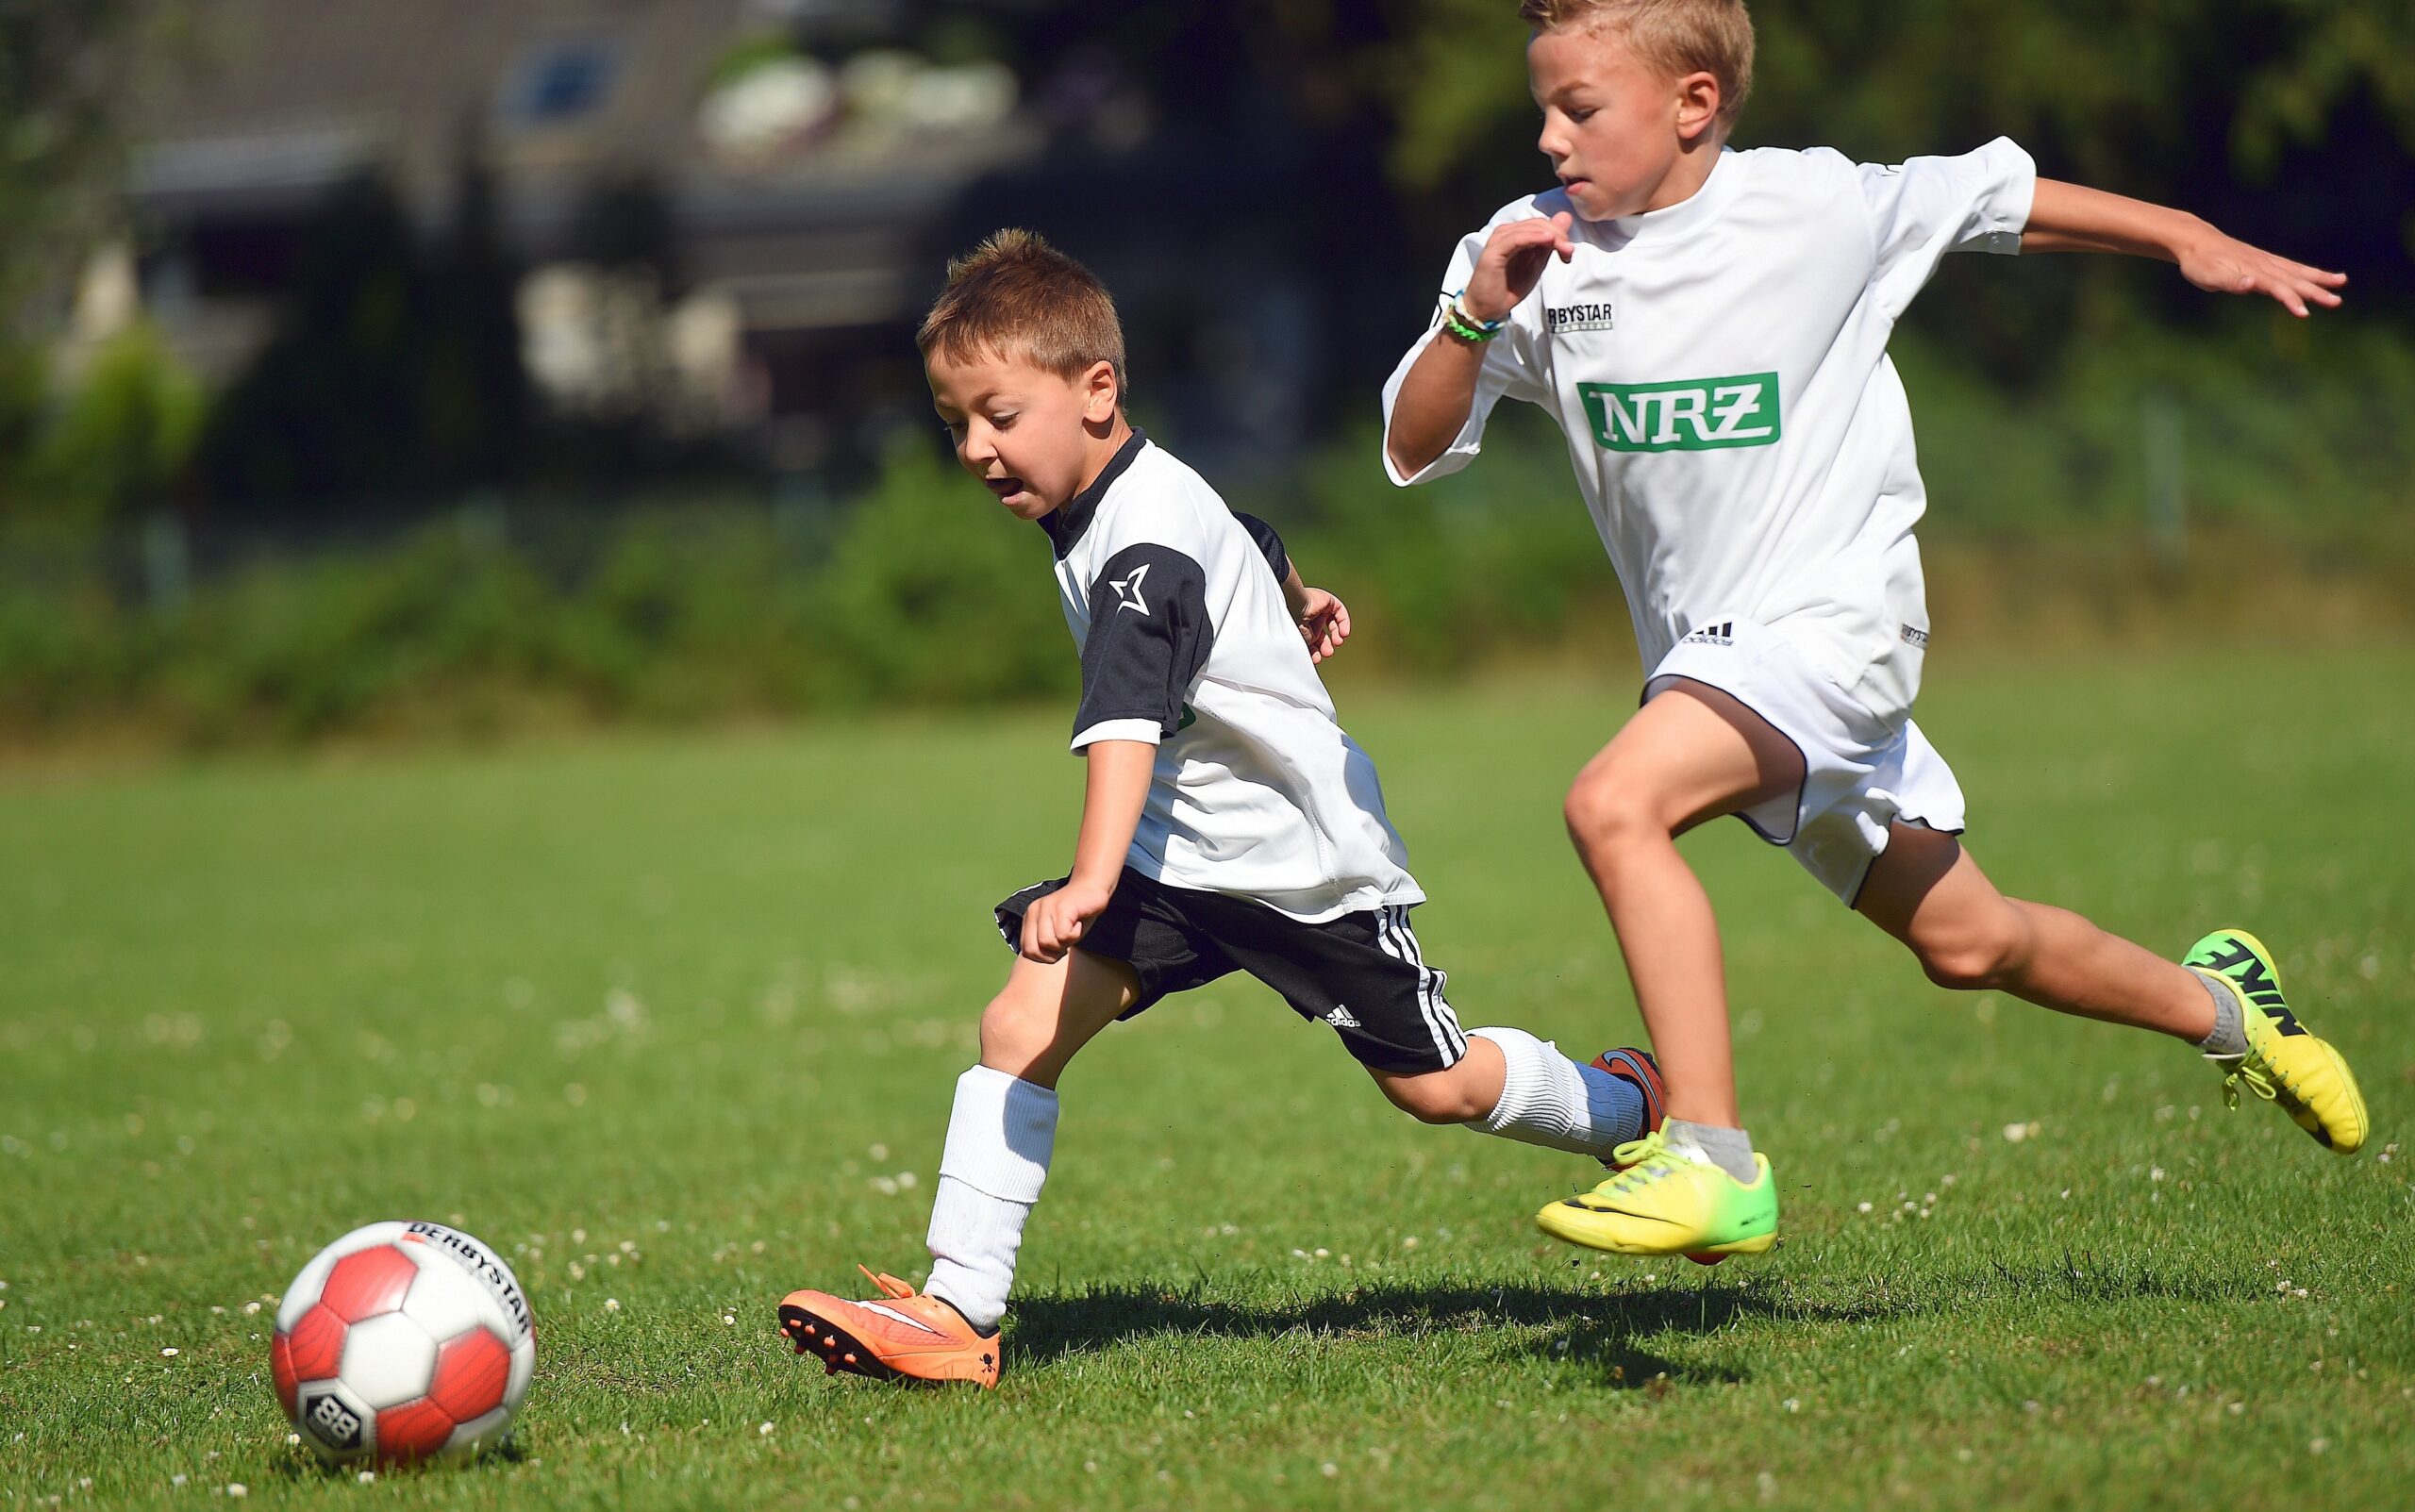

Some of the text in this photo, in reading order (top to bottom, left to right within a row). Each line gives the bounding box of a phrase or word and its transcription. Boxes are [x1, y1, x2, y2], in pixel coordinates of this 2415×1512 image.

[1588, 383, 1773, 444] NRZ
[2190, 938, 2308, 1037] NIKE
[408, 1222, 530, 1335] DERBYSTAR
[314, 1396, 360, 1440] 88
